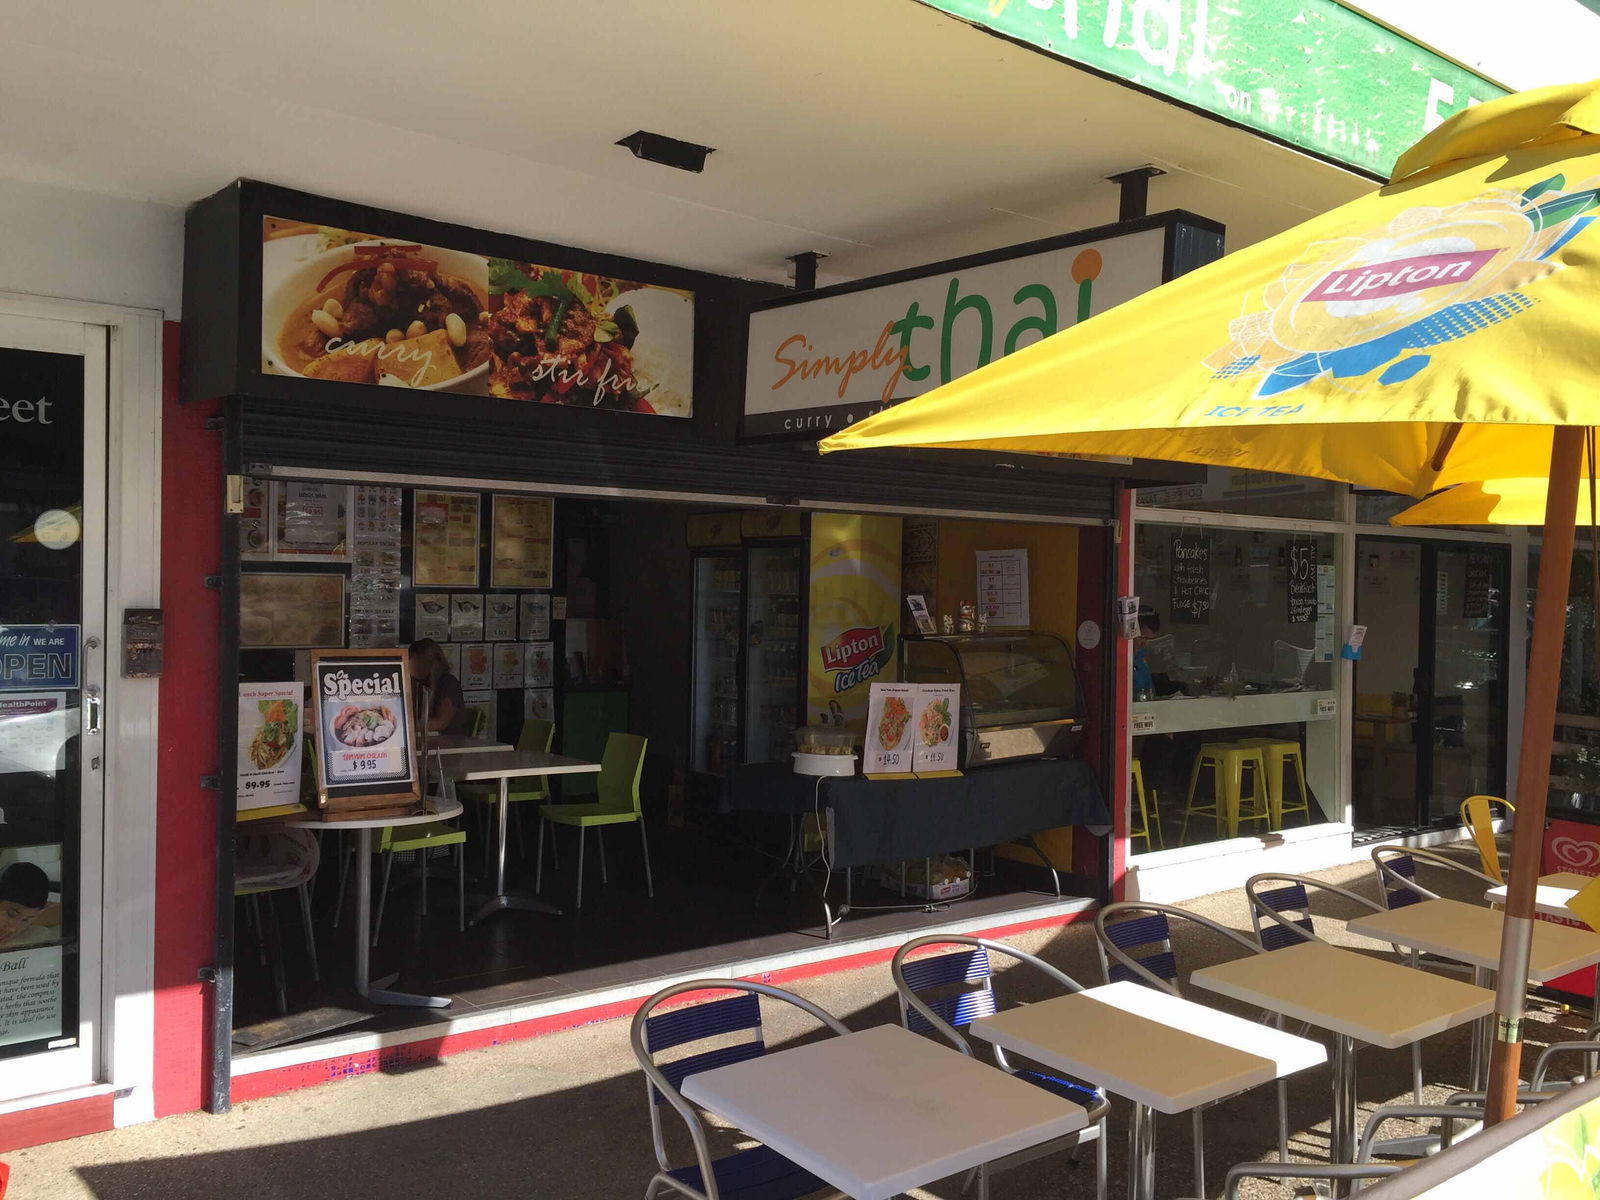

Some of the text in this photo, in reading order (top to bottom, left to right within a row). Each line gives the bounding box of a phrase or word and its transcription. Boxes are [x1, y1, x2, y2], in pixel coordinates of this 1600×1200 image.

[1321, 260, 1473, 297] Lipton
[772, 248, 1103, 402] Simply thai
[325, 336, 436, 387] curry
[532, 356, 588, 386] stir
[784, 414, 832, 430] curry
[1256, 403, 1305, 417] TEA
[1173, 538, 1208, 561] Pancakes
[1290, 545, 1309, 580] $5
[18, 634, 31, 646] in
[33, 638, 47, 646] WE
[48, 638, 65, 646] ARE
[825, 635, 879, 663] Lipton
[0, 652, 72, 681] PEN
[835, 660, 879, 692] Ice Tea
[323, 672, 401, 700] Special
[245, 780, 271, 789] $9.95
[1, 957, 30, 972] Ball
